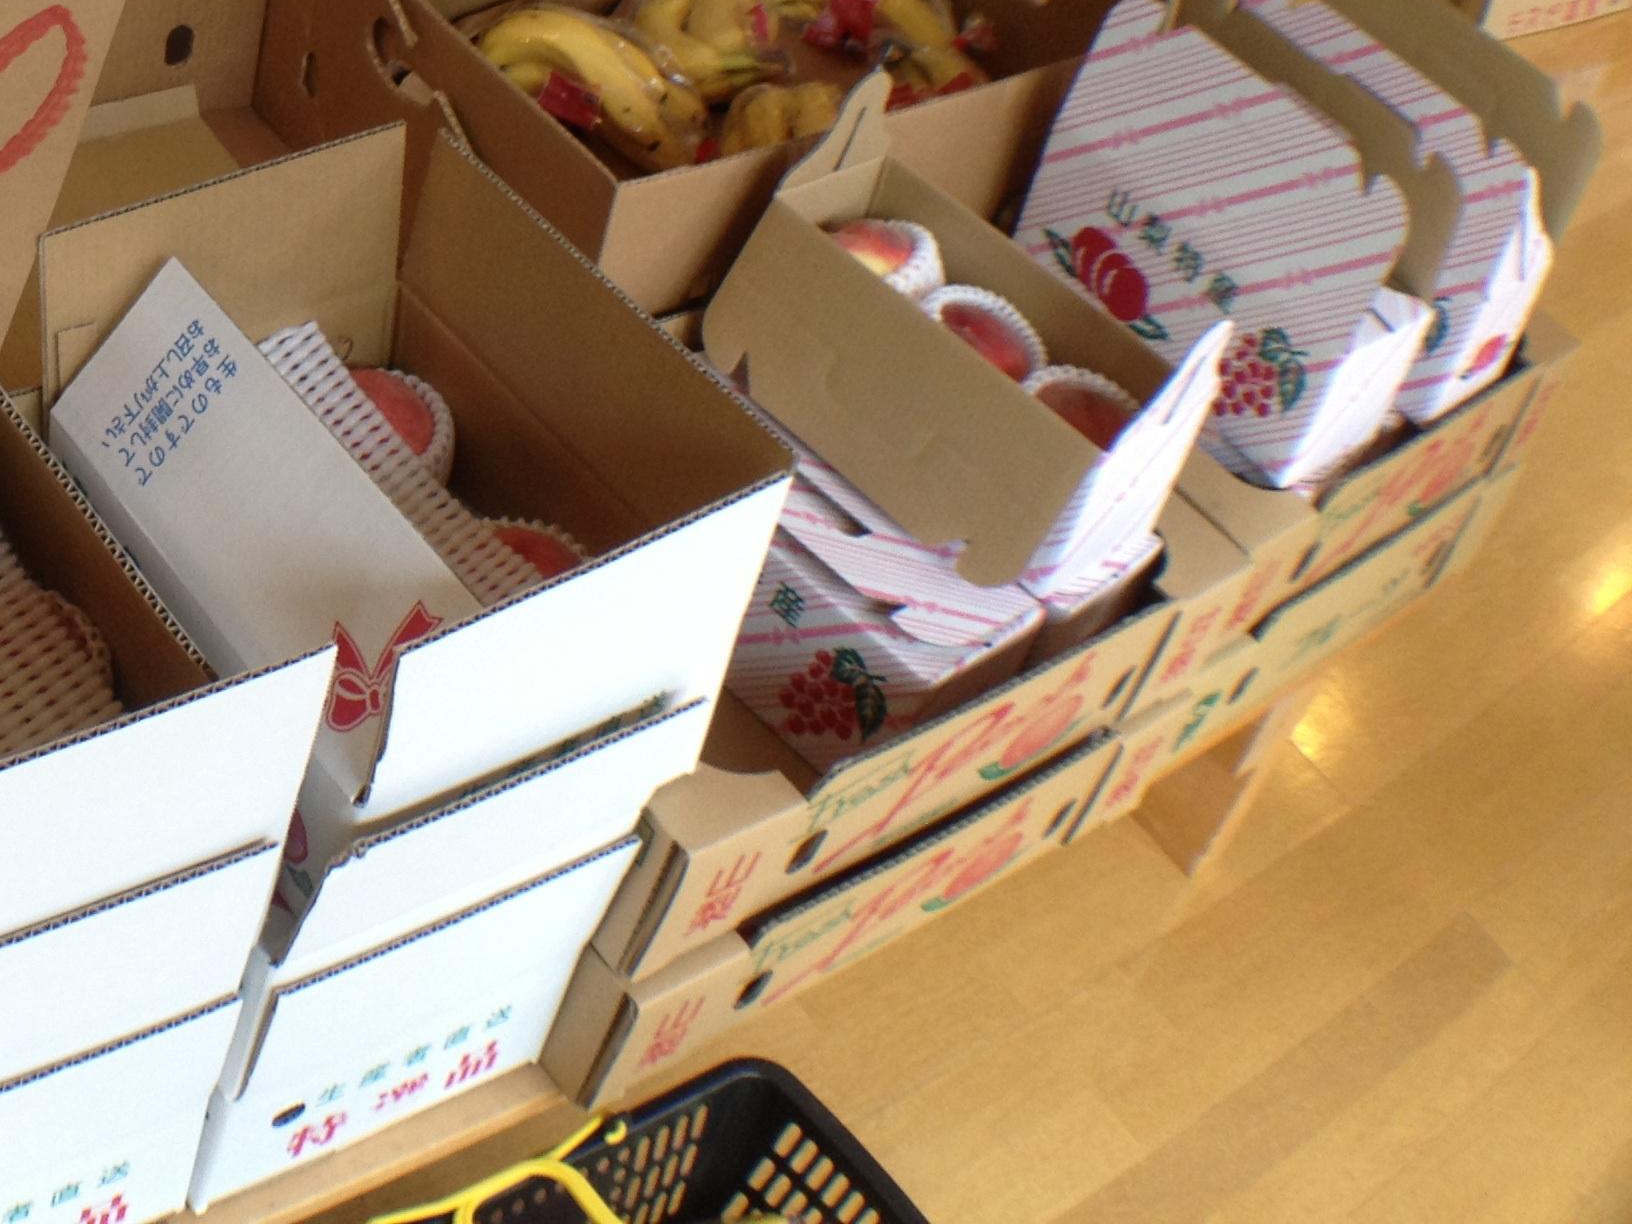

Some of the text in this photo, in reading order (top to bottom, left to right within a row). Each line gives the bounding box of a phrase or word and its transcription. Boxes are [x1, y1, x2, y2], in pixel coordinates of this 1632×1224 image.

[101, 320, 205, 447] お召し上がり下さい
[119, 338, 220, 466] お早めに開封して
[135, 355, 238, 487] 生ものですので
